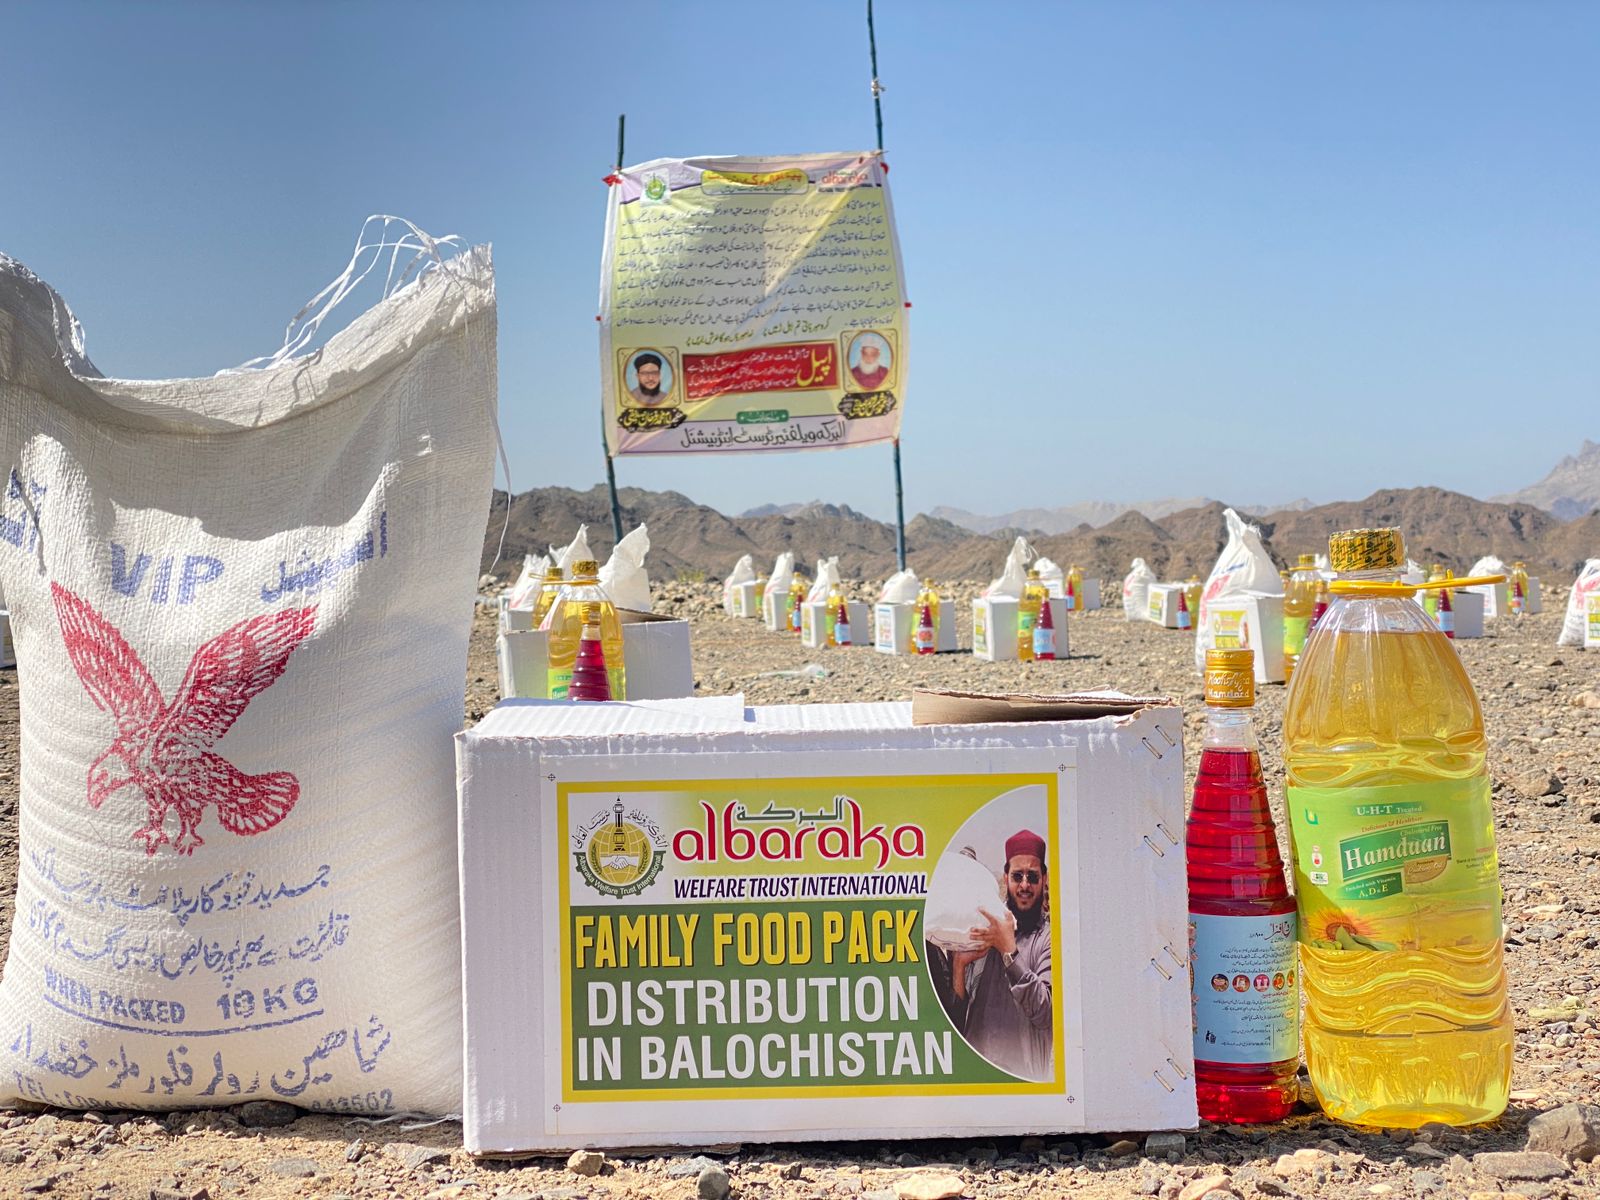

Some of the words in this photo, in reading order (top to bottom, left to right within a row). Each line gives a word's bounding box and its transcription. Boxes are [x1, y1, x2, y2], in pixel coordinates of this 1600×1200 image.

[109, 541, 225, 604] VIP
[672, 799, 925, 869] albaraka
[579, 855, 595, 883] Albaraka
[594, 879, 619, 895] Welfare
[620, 886, 639, 895] Trust
[636, 854, 663, 888] International
[674, 877, 747, 899] WELFARE
[749, 876, 800, 897] TRUST
[801, 873, 928, 896] INTERNATIONAL
[575, 913, 701, 969] FAMILY
[714, 911, 814, 967] FOOD
[823, 909, 920, 965] PACK
[45, 965, 93, 1009] WHEN
[99, 990, 186, 1024] PACKED
[586, 974, 919, 1028] DISTRIBUTION
[578, 1036, 623, 1082] IN
[641, 1030, 954, 1081] BALOCHISTAN
